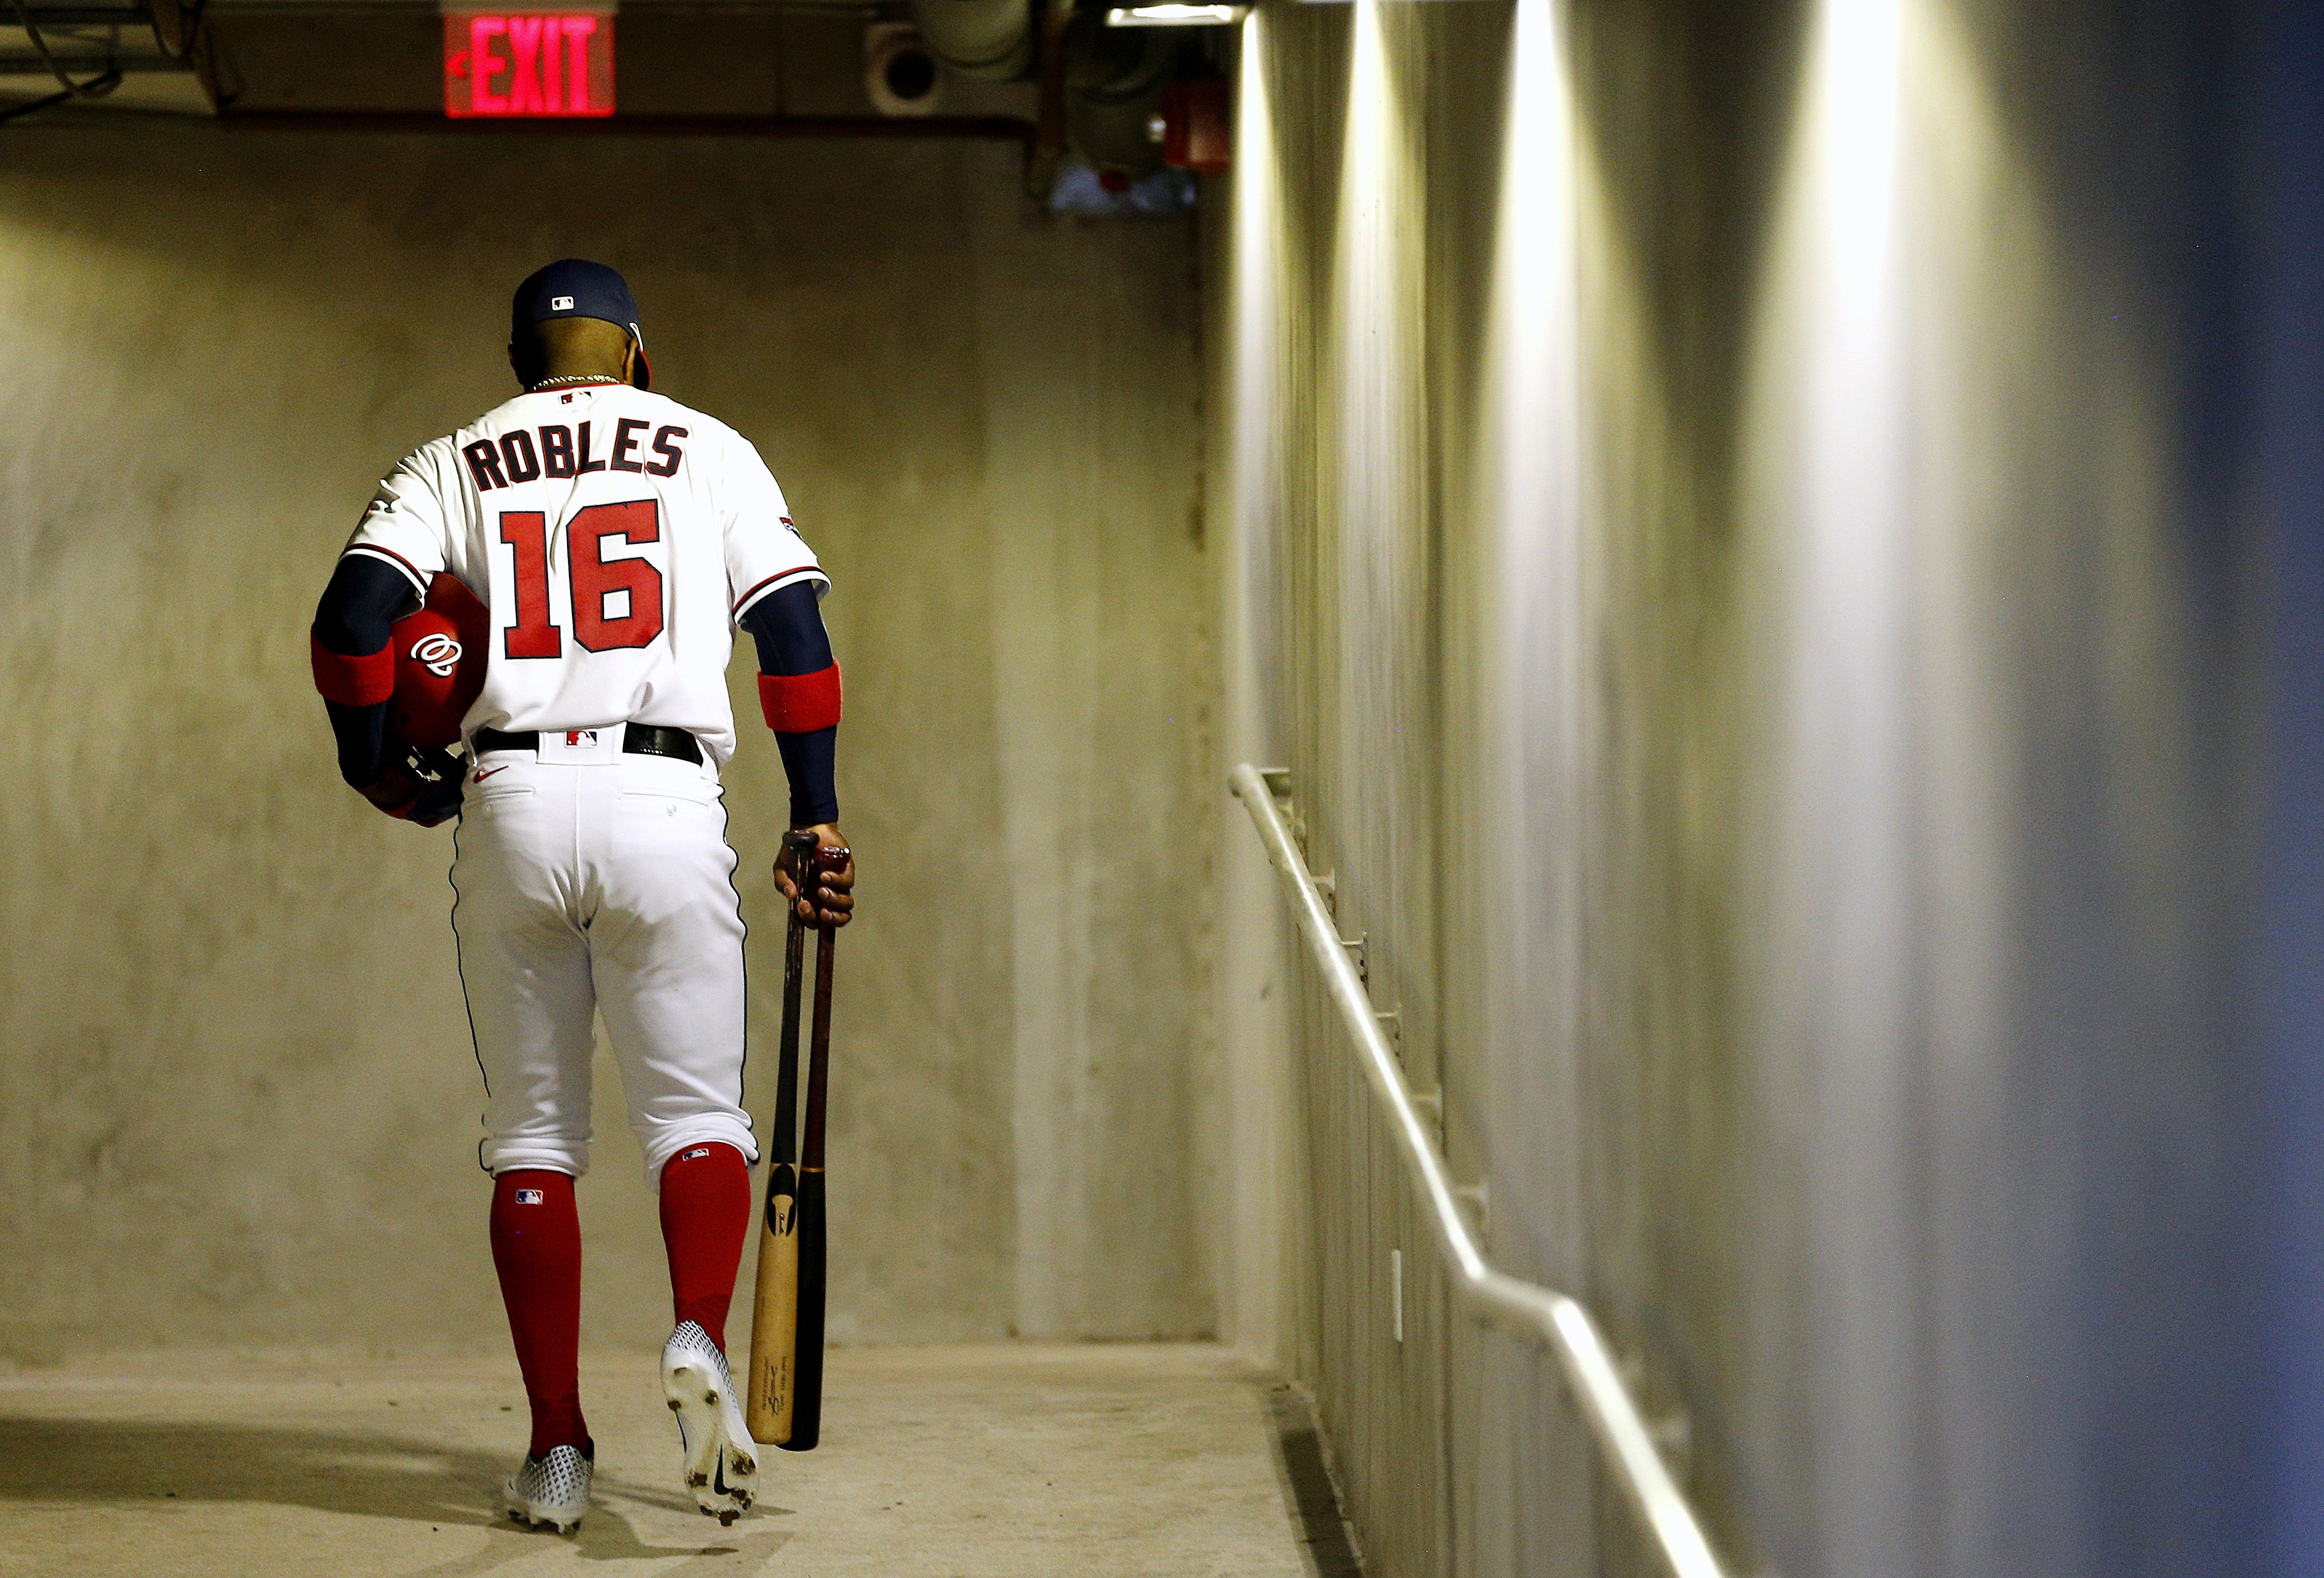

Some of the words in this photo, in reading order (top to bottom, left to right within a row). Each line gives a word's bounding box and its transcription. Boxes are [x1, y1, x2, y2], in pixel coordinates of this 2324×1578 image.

[471, 17, 596, 111] EXIT
[462, 418, 689, 491] ROBLES
[499, 499, 664, 660] 16
